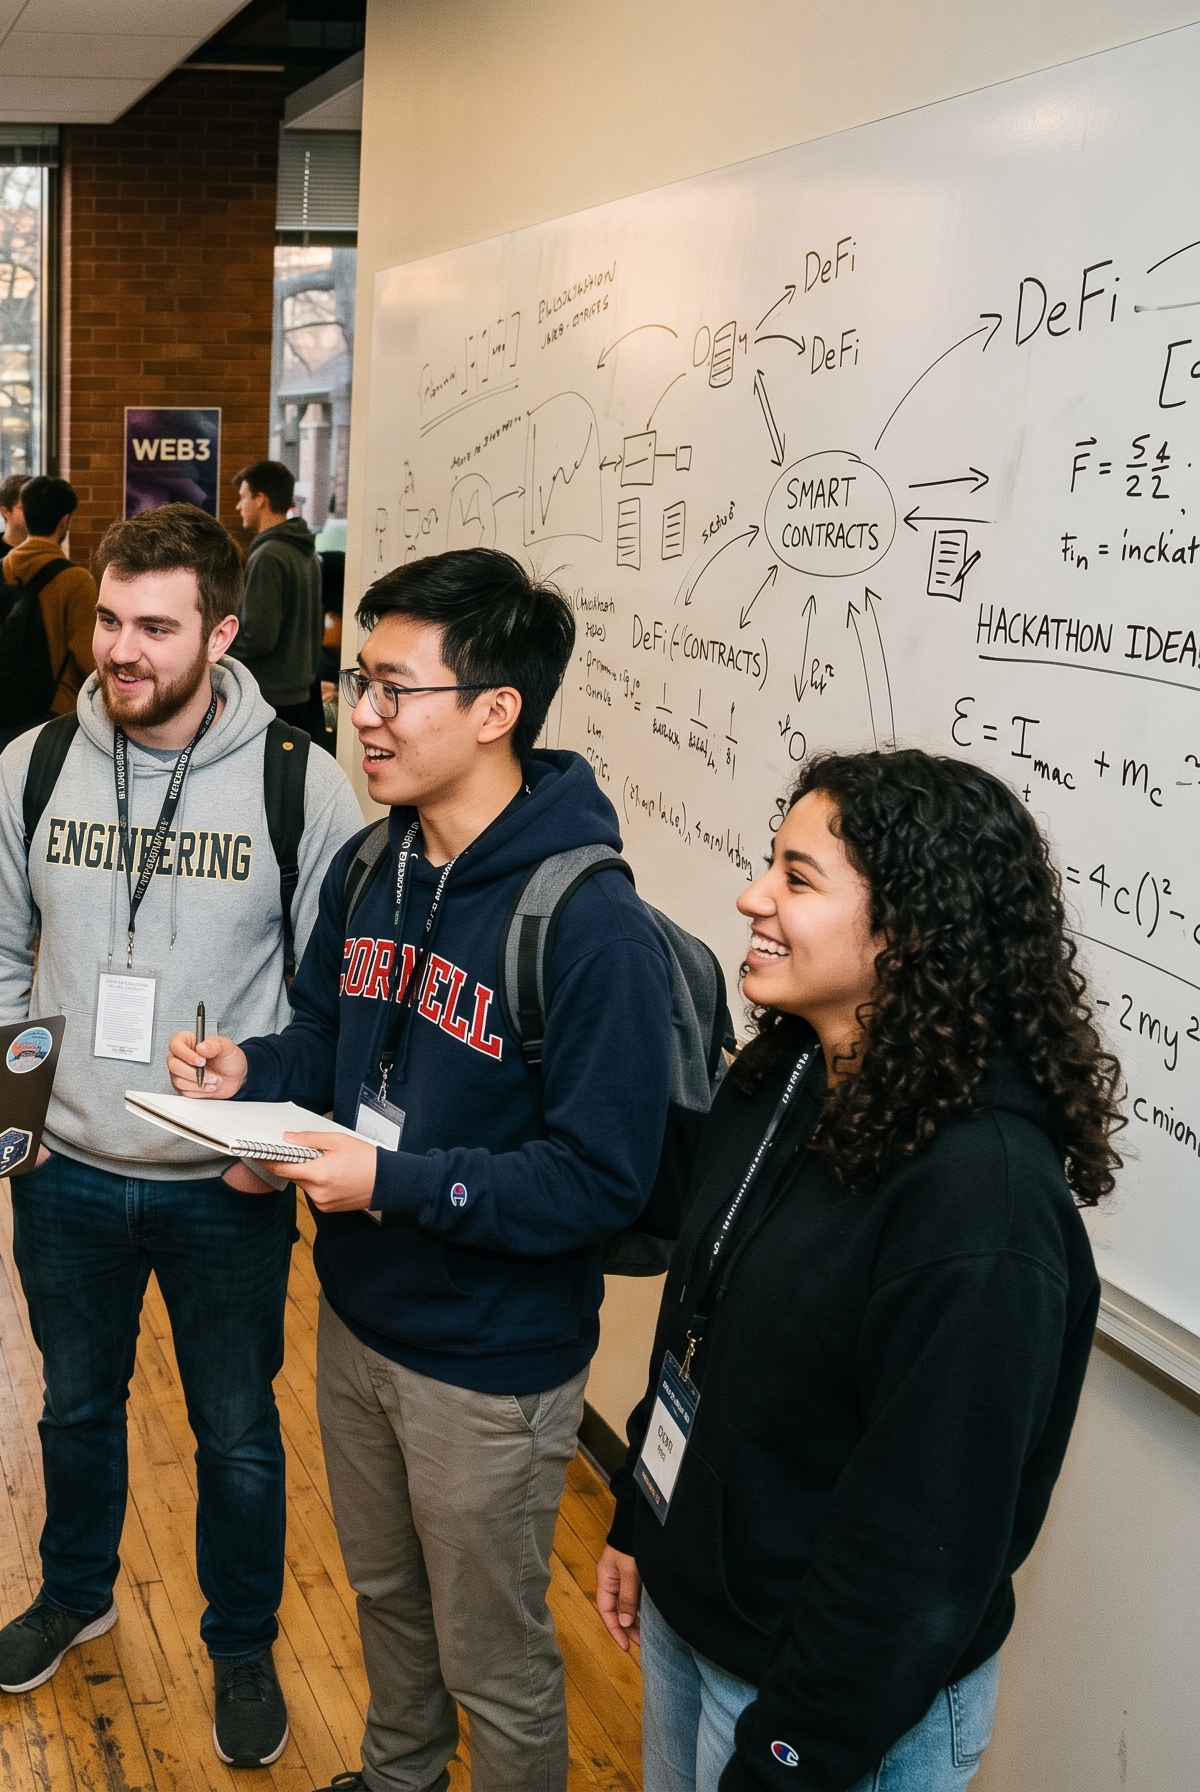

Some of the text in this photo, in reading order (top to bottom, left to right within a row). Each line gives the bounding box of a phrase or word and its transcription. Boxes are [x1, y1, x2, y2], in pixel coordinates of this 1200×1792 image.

[804, 236, 857, 293] DeFi
[1015, 259, 1121, 347] DeFi
[811, 328, 860, 374] DeFi
[132, 438, 211, 461] WEB3
[786, 476, 857, 511] SMART
[781, 523, 880, 551] CONTRACTS
[976, 603, 1200, 670] HACKATHON IDEA
[46, 818, 252, 882] ENGINEERING
